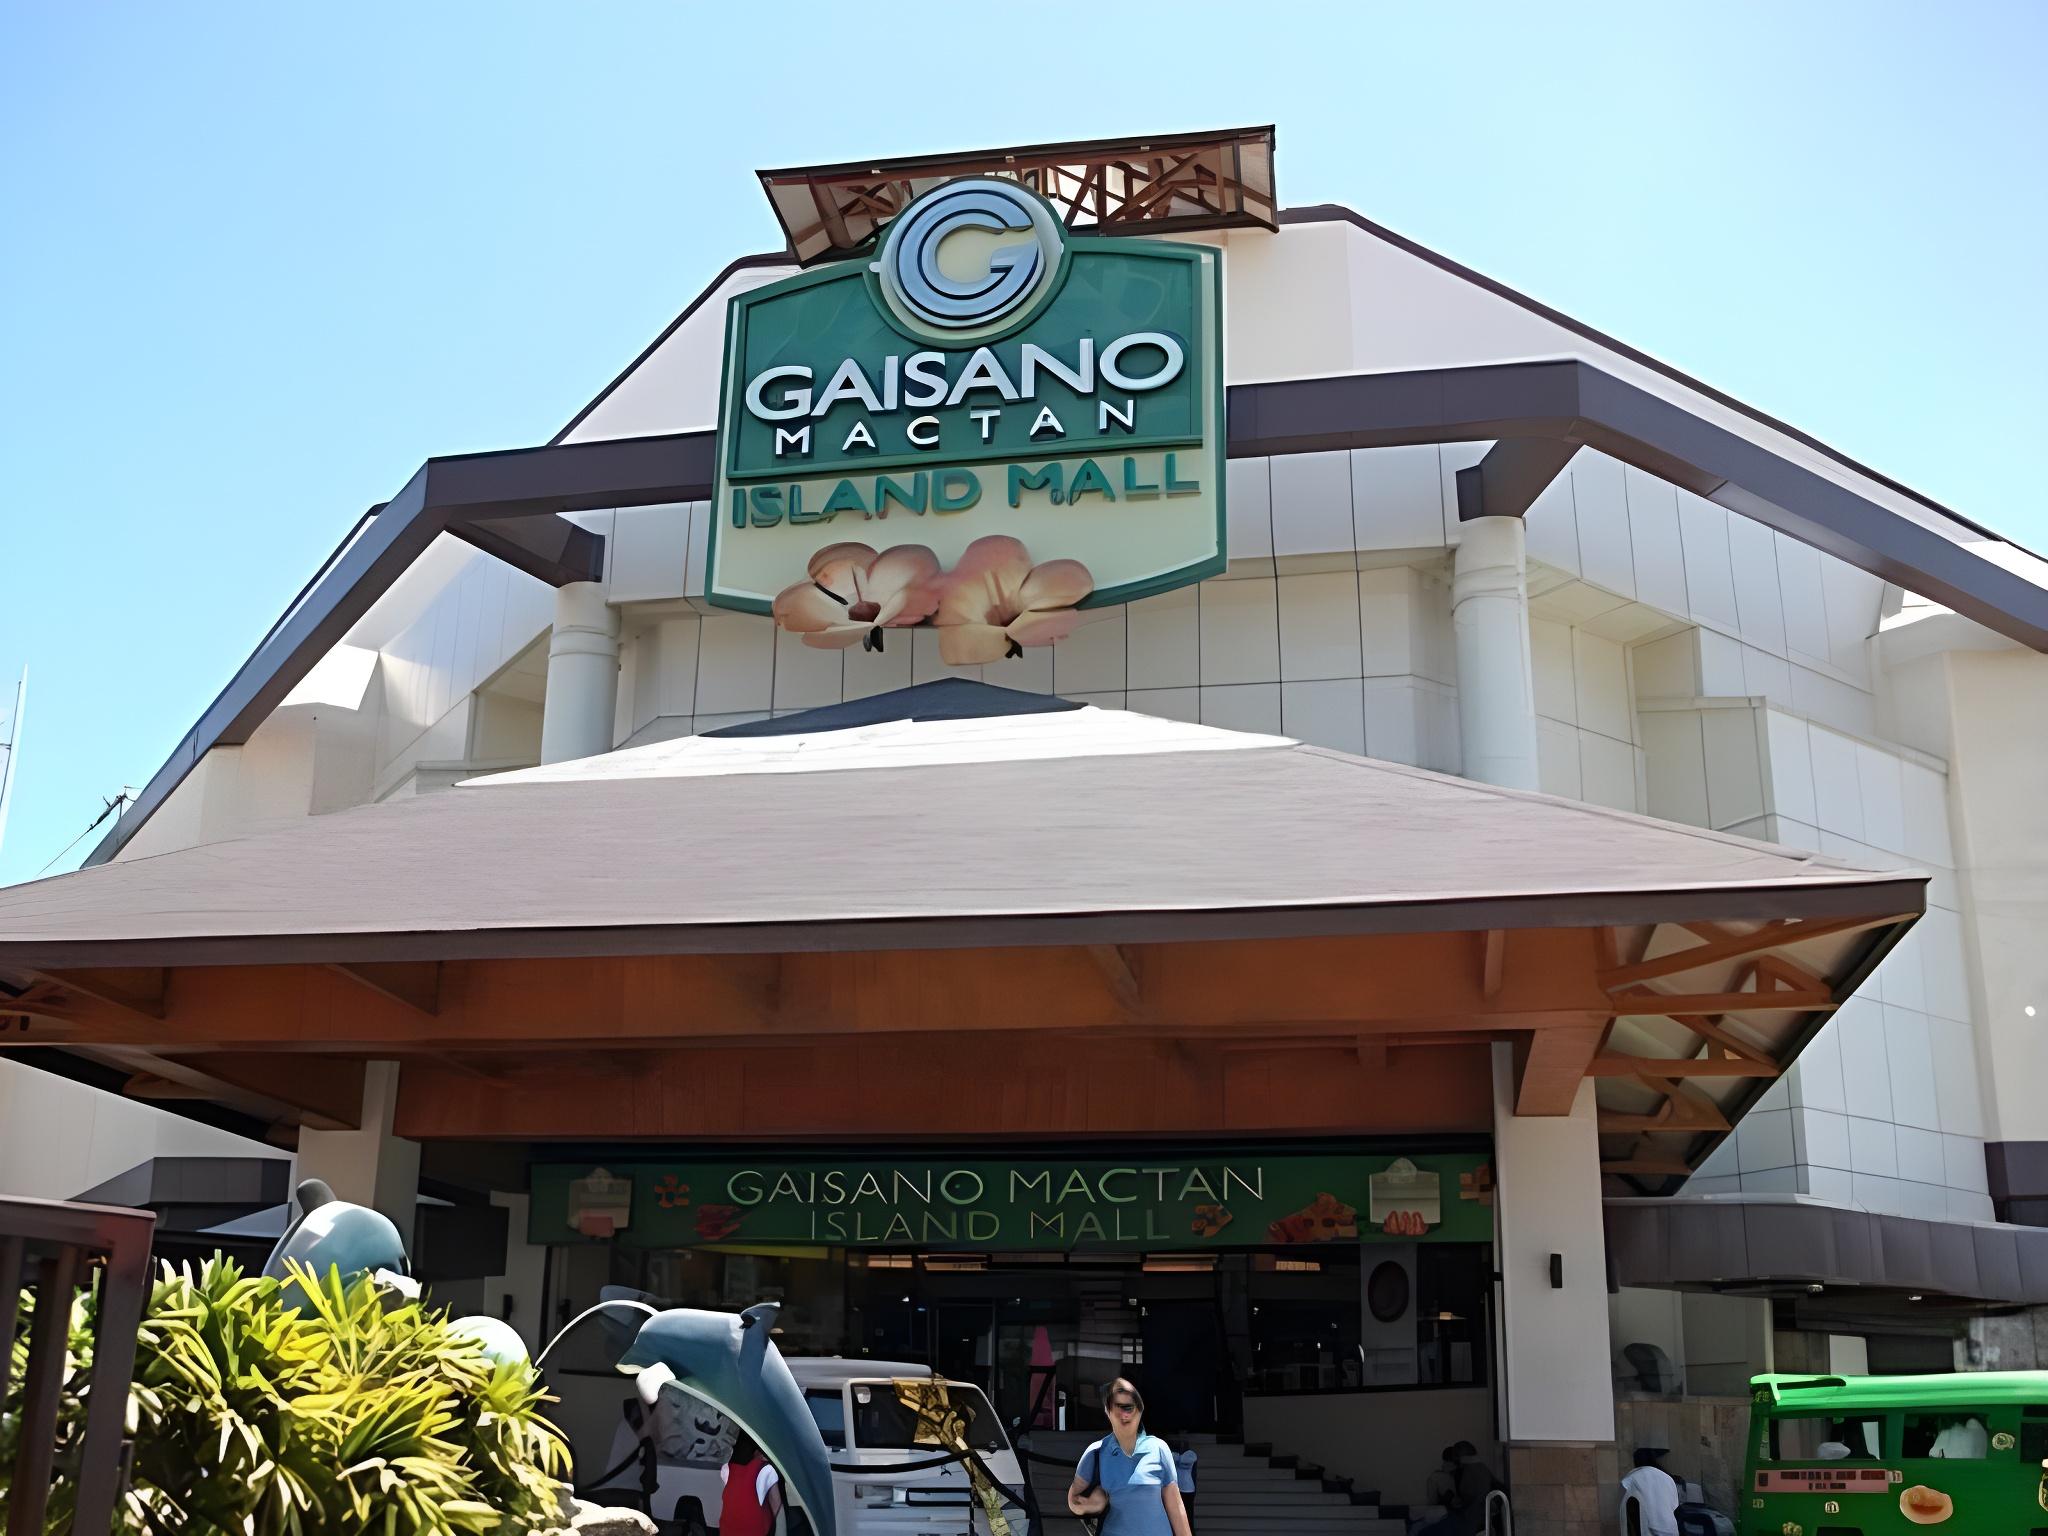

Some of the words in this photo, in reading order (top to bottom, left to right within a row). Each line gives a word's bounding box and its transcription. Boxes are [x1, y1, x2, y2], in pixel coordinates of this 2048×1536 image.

[745, 331, 1185, 421] GAISANO
[775, 399, 1137, 457] MACTAN
[732, 467, 983, 529] ISLAND
[1006, 453, 1202, 508] MALL
[727, 1170, 985, 1206] GAISANO
[1009, 1166, 1263, 1204] MACTAN
[810, 1210, 1001, 1242] ISLAND
[1030, 1207, 1171, 1241] MALL
